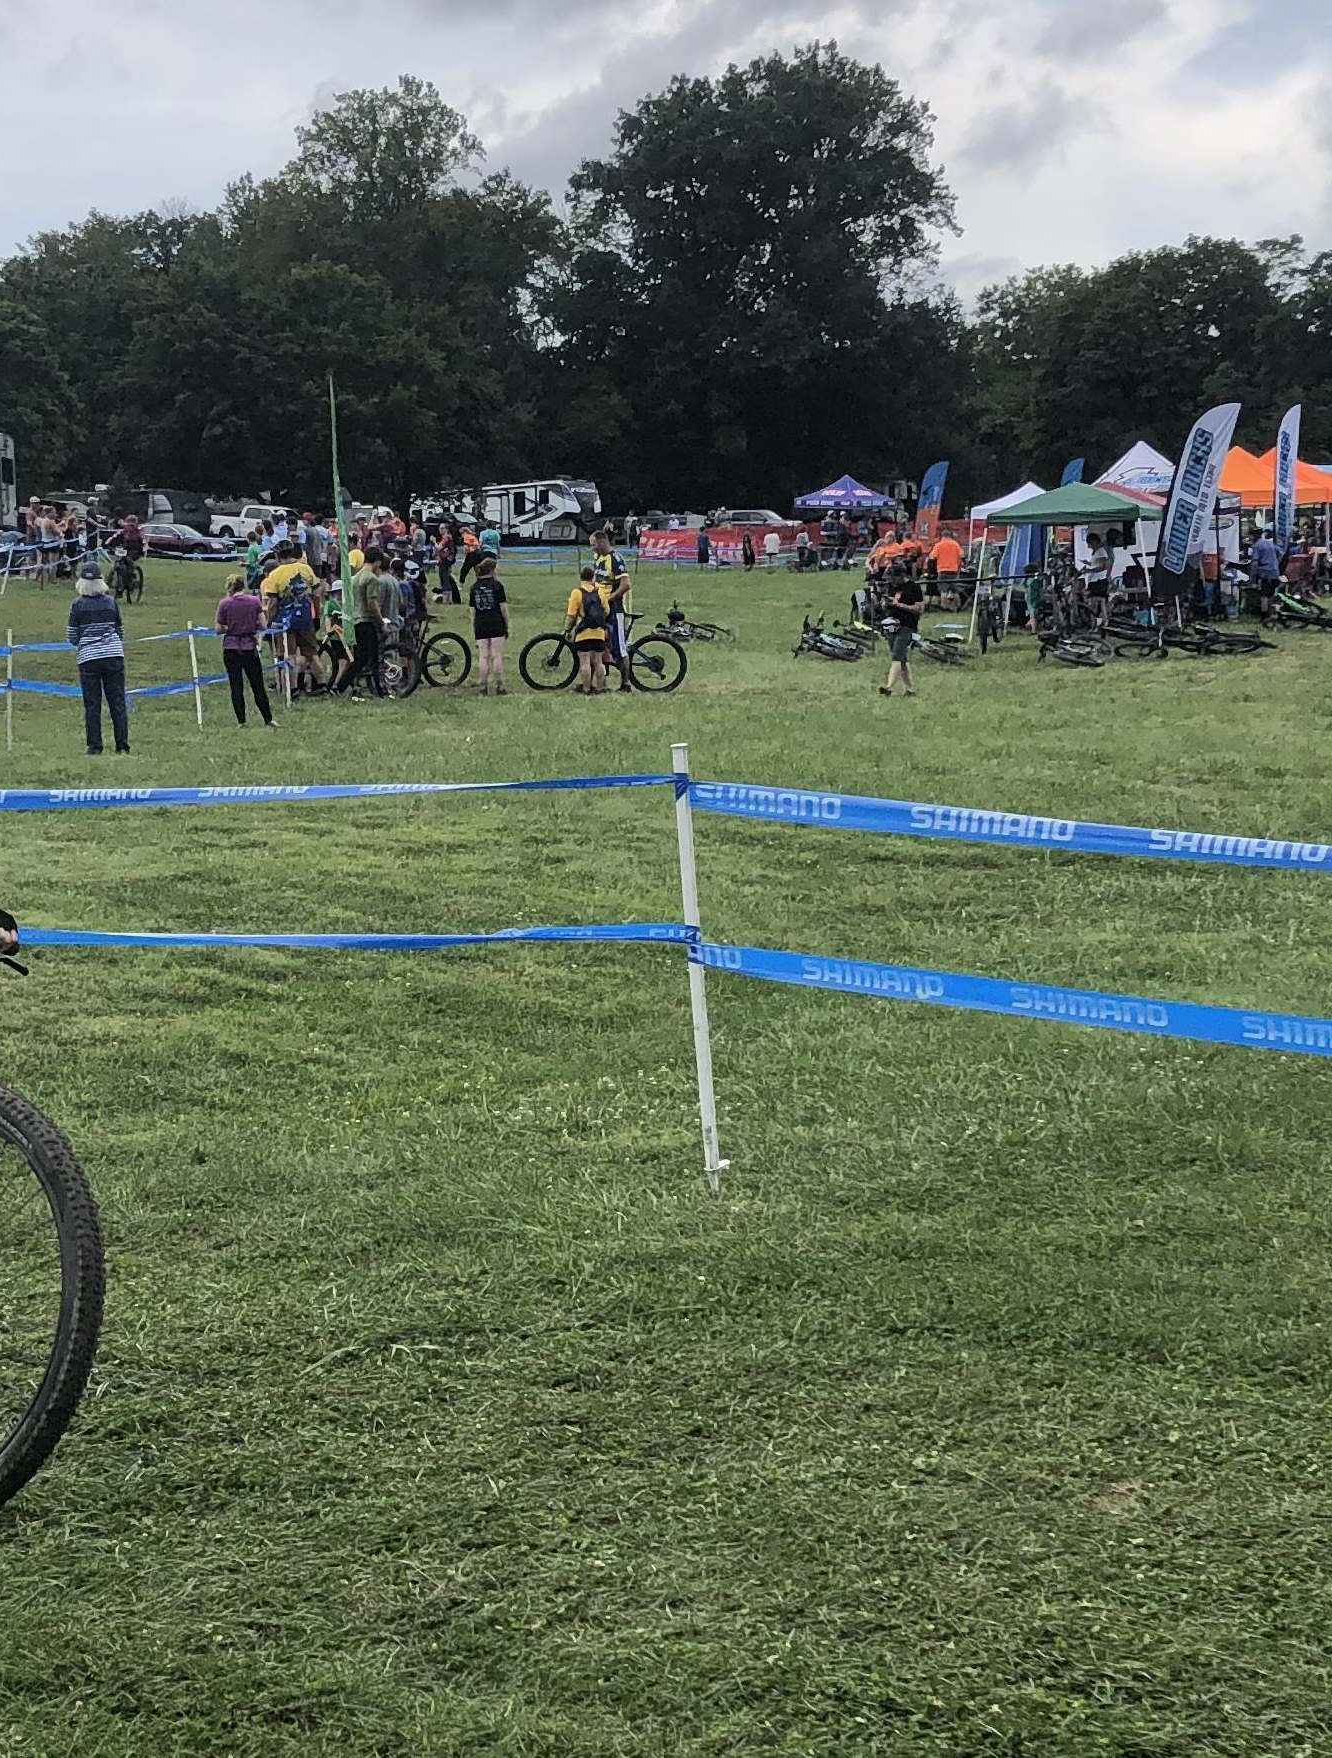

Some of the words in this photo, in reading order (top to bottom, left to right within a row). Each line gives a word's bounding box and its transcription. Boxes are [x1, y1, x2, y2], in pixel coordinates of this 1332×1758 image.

[910, 806, 1076, 841] SHIMANO
[1148, 828, 1327, 863] SHIMANO
[801, 956, 945, 999] SHIMANO
[1009, 986, 1168, 1028] SHIMANO
[1241, 1014, 1332, 1048] SHIM
